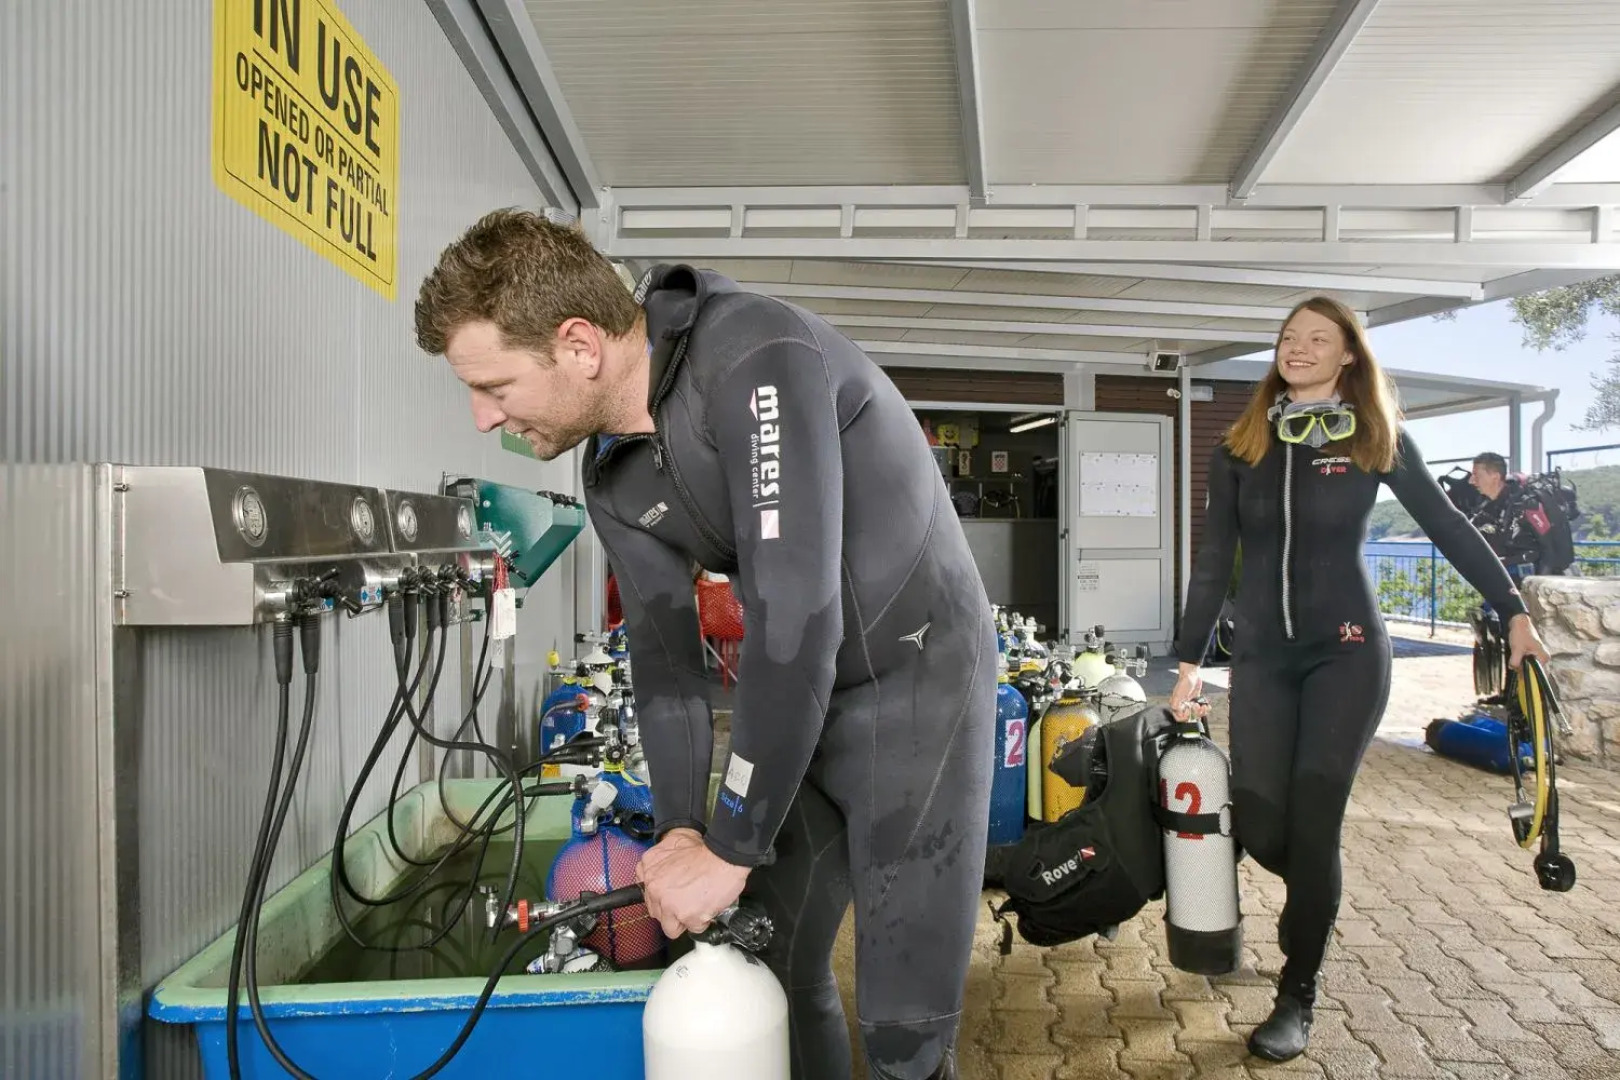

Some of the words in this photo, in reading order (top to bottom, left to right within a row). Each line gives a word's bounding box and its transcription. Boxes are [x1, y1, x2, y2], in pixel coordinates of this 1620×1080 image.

[236, 51, 310, 145] OPENED
[315, 125, 334, 168] OR
[339, 146, 389, 217] PARTIAL
[318, 18, 381, 159] USE
[258, 117, 318, 215] NOT
[326, 175, 377, 262] FULL
[750, 433, 759, 464] diving
[751, 467, 759, 499] center
[757, 385, 780, 497] mares
[1007, 721, 1025, 766] 2
